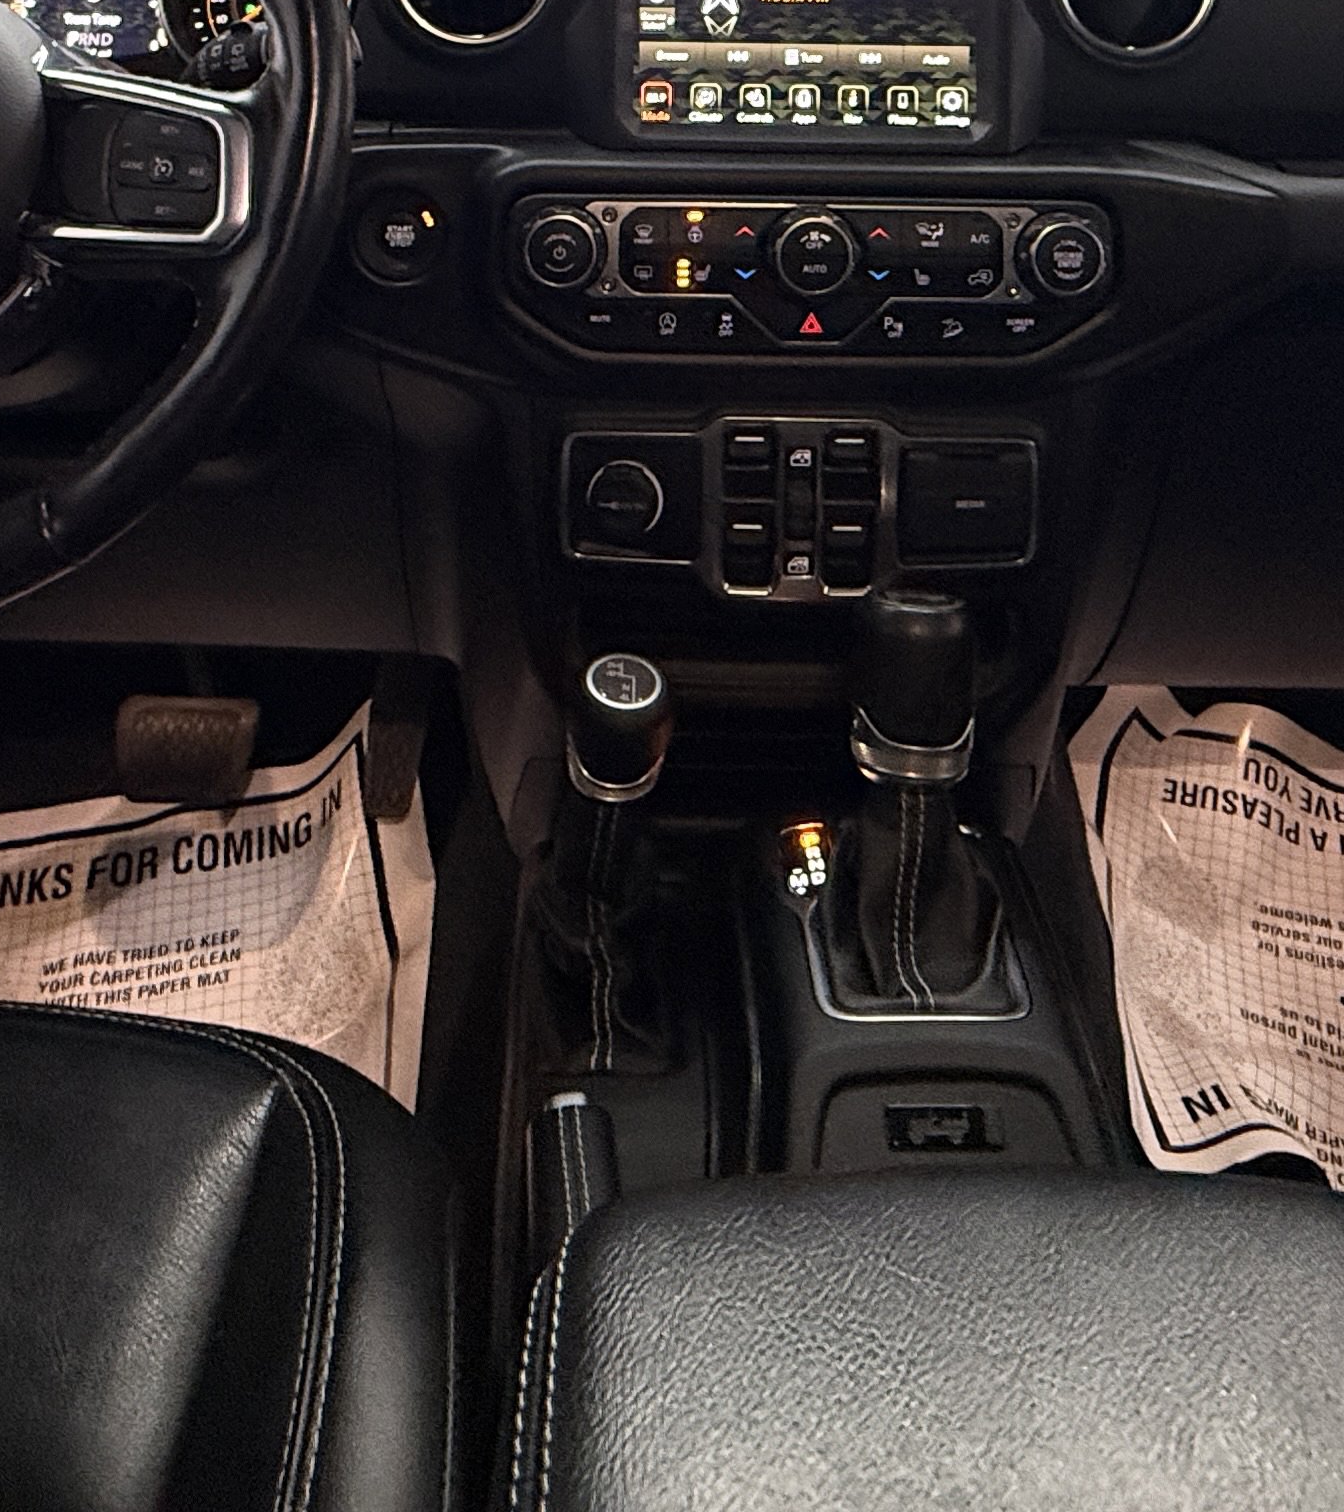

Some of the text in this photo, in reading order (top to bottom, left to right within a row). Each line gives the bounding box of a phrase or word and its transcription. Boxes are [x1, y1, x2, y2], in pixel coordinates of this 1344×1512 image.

[805, 240, 824, 250] OFF
[970, 233, 991, 245] A/C
[802, 264, 828, 274] AUTO
[884, 316, 894, 330] P
[1006, 318, 1035, 326] SCREEN
[1242, 756, 1294, 803] YOU
[1161, 777, 1301, 847] PLEASURE
[86, 845, 160, 890] FOR
[171, 812, 312, 875] COMING
[320, 778, 343, 827] IN
[1309, 828, 1328, 853] A
[808, 858, 825, 872] N
[789, 872, 809, 888] M
[810, 871, 826, 886] D
[1251, 919, 1311, 944] service
[42, 928, 240, 976] WE HAVE TRIED TO KEEP
[1257, 939, 1280, 958] for
[1316, 934, 1343, 951] our
[38, 947, 241, 995] YOUR CARPETING CLEAN
[94, 986, 132, 1007] THIS
[136, 976, 192, 1000] PAPER
[196, 968, 232, 990] MAT
[1239, 1007, 1298, 1040] person
[1304, 1014, 1321, 1032] to
[1181, 1083, 1232, 1124] IN
